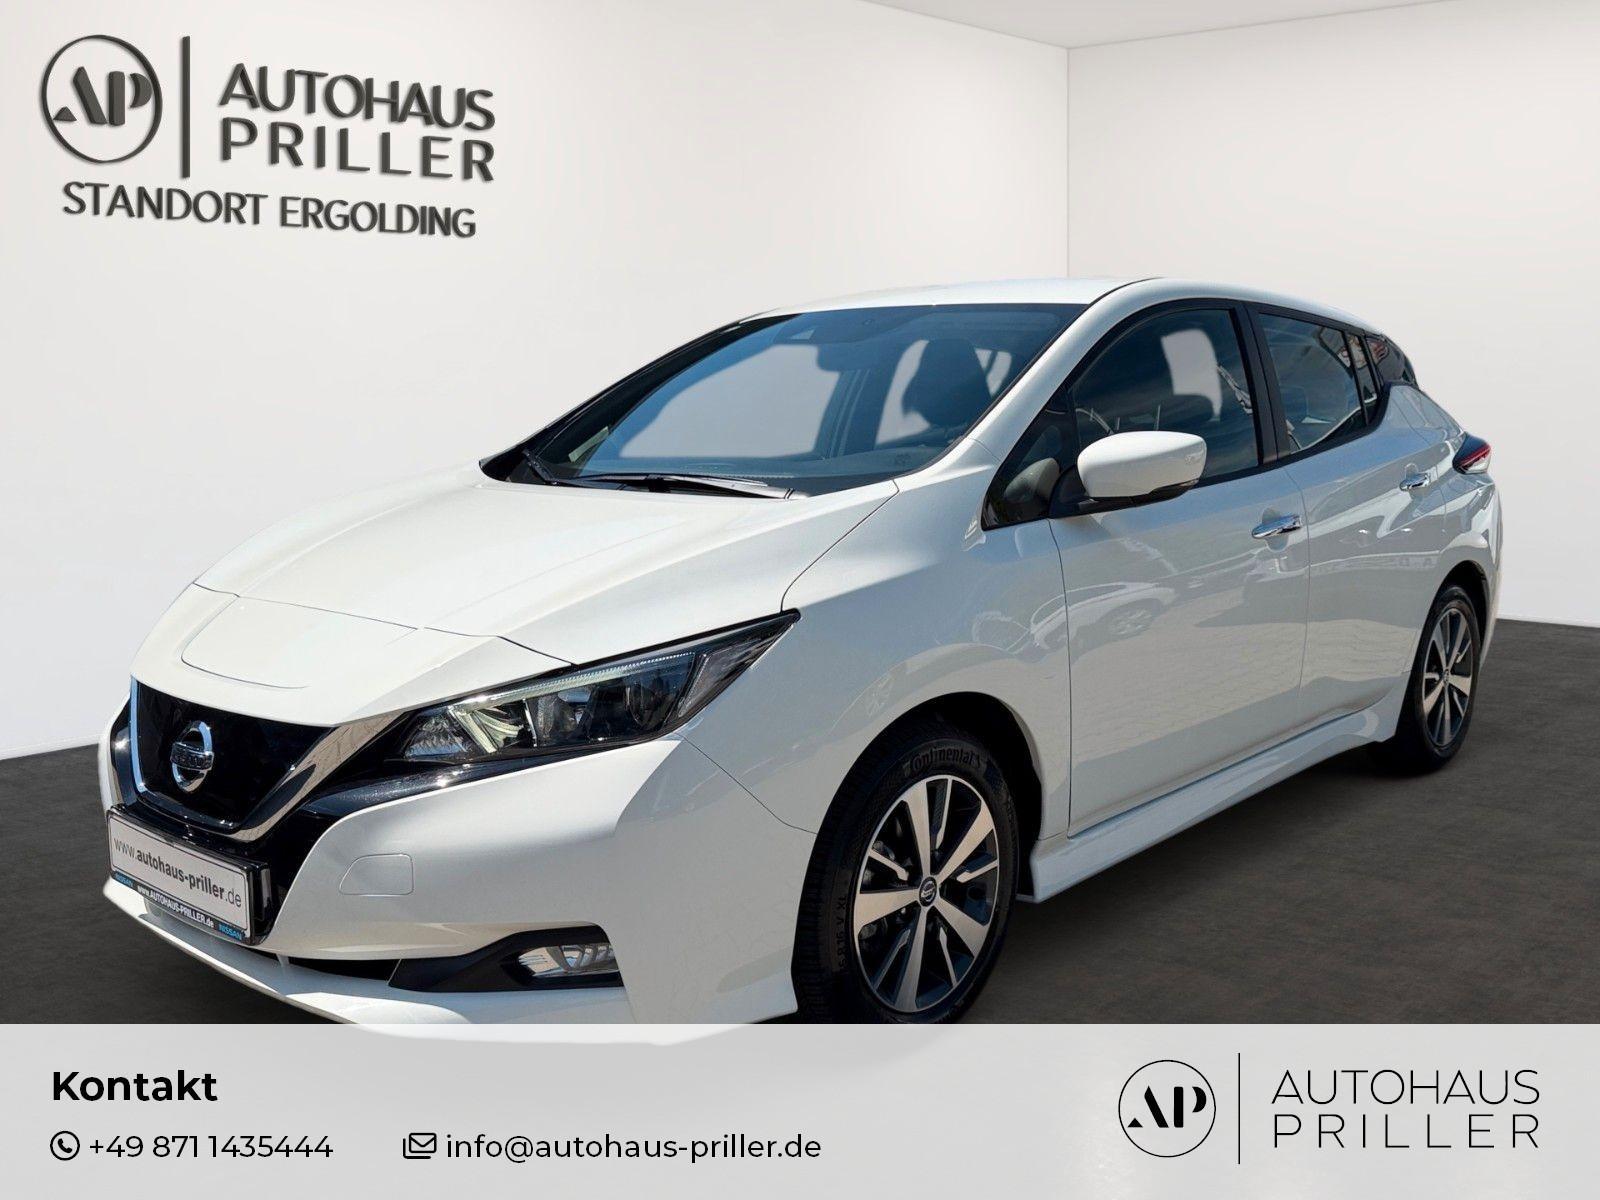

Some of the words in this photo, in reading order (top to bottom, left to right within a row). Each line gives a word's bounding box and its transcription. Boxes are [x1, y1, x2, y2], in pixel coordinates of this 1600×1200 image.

[219, 62, 496, 131] AUTOHAUS
[221, 117, 495, 182] PRILLER
[62, 181, 269, 225] STANDORT
[280, 196, 477, 238] ERGOLDING
[113, 838, 242, 908] www.autohaus-priller.de
